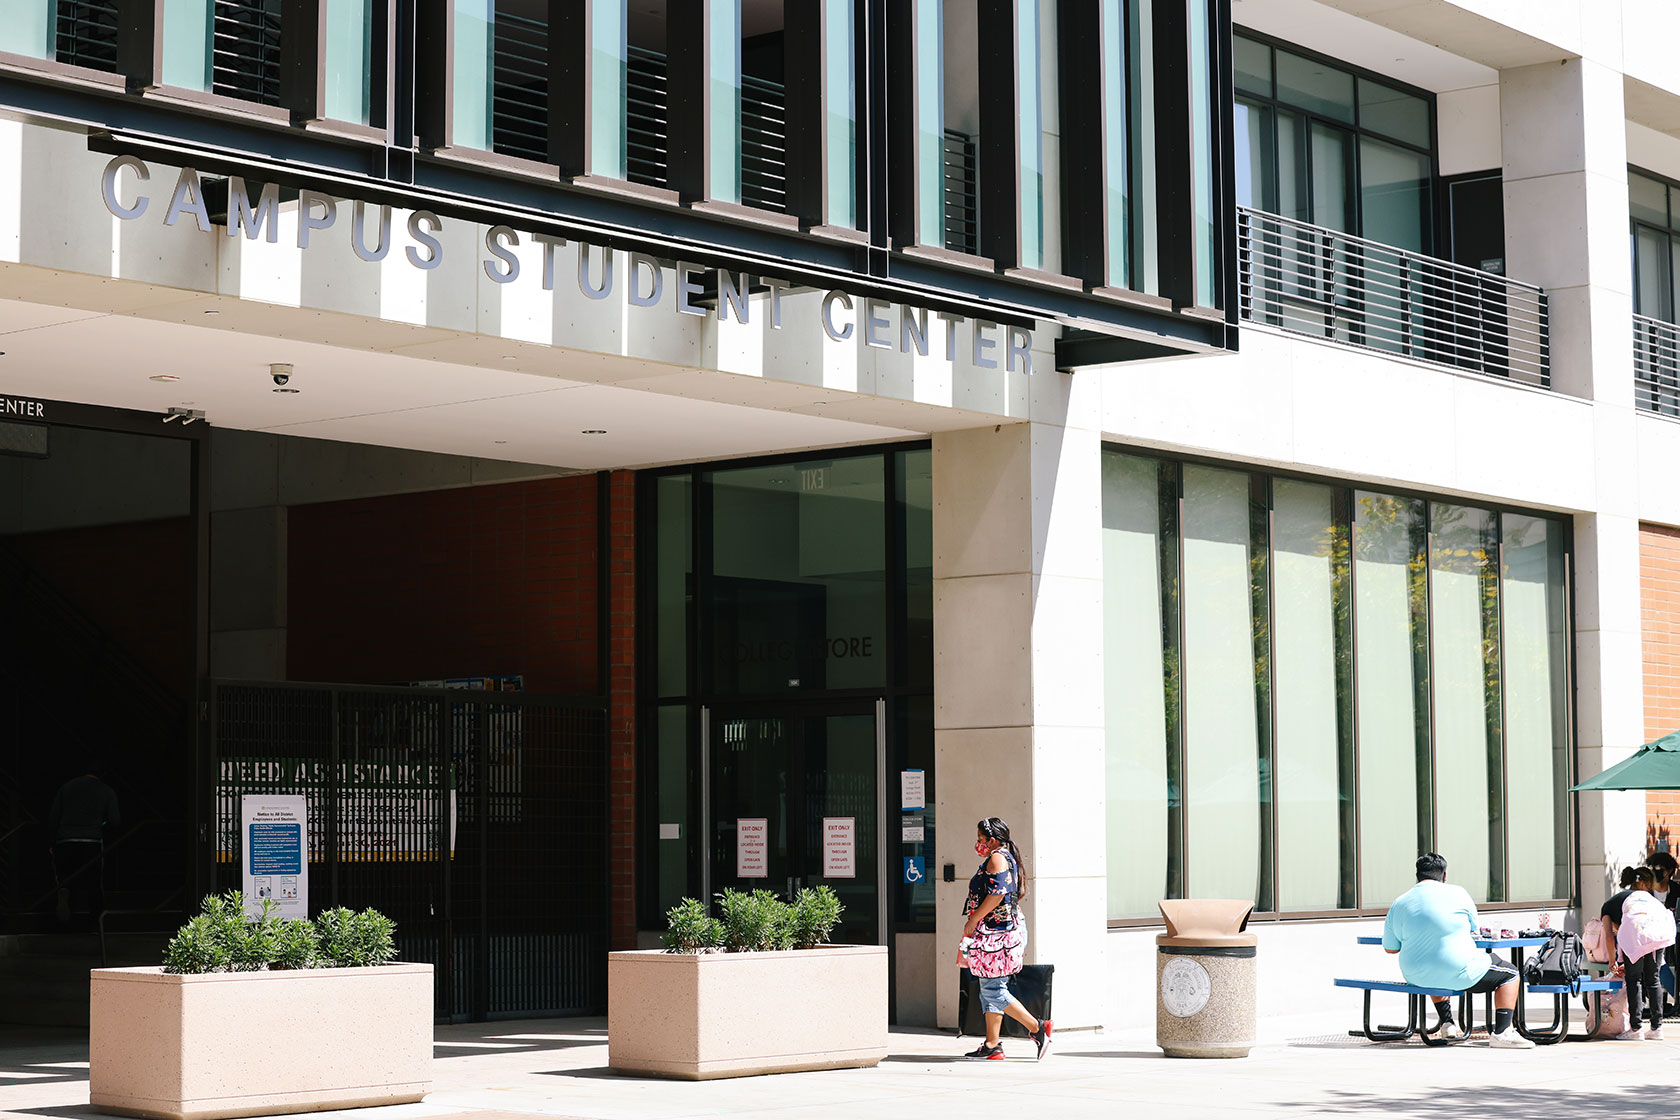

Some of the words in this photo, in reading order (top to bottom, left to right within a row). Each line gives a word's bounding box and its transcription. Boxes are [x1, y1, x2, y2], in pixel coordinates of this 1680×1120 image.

[101, 154, 443, 270] CAMPUS
[482, 224, 790, 330] STUDENT
[821, 289, 1033, 375] CENTER
[221, 761, 284, 782] NEED
